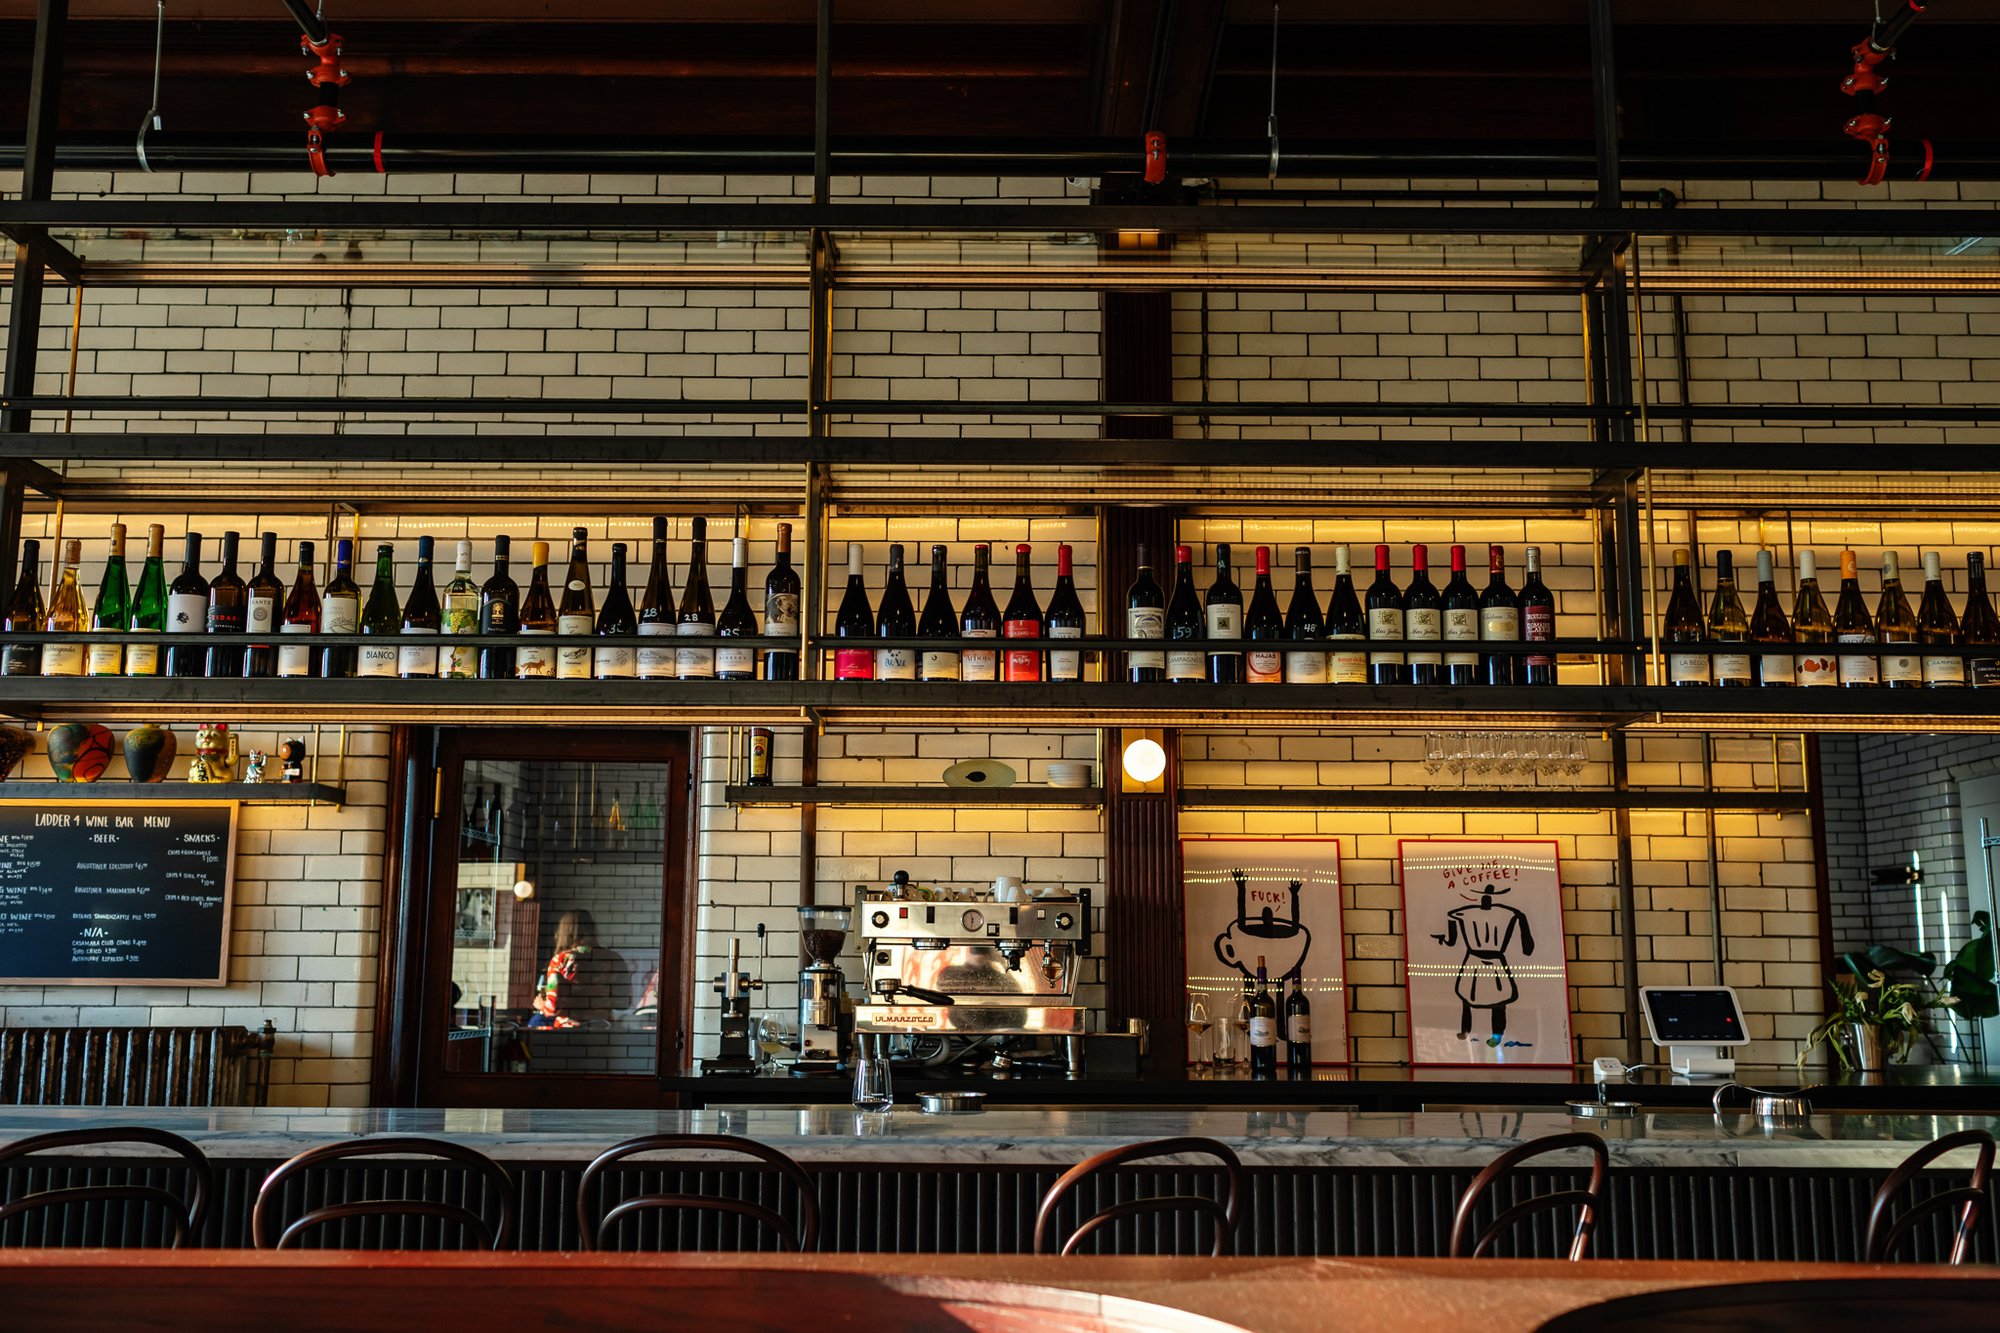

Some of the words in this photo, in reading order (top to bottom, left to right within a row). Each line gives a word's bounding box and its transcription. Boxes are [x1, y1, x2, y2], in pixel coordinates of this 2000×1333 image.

[643, 607, 657, 618] 28
[684, 613, 699, 622] 28
[1177, 626, 1192, 639] 59
[1303, 623, 1317, 633] 48
[366, 650, 395, 660] BIANCO
[35, 813, 71, 828] LADDER
[73, 814, 81, 828] 4
[85, 815, 108, 828] WINE
[115, 815, 135, 829] BAR
[143, 815, 171, 829] MENU
[1443, 863, 1472, 879] GIVE
[1447, 880, 1456, 890] A
[1462, 867, 1518, 886] COFFEE!
[6, 886, 28, 895] WINE
[1251, 890, 1286, 904] FUCK!
[10, 912, 33, 921] WINE
[875, 1015, 884, 1023] LA
[887, 1015, 934, 1023] MARZOCCO
